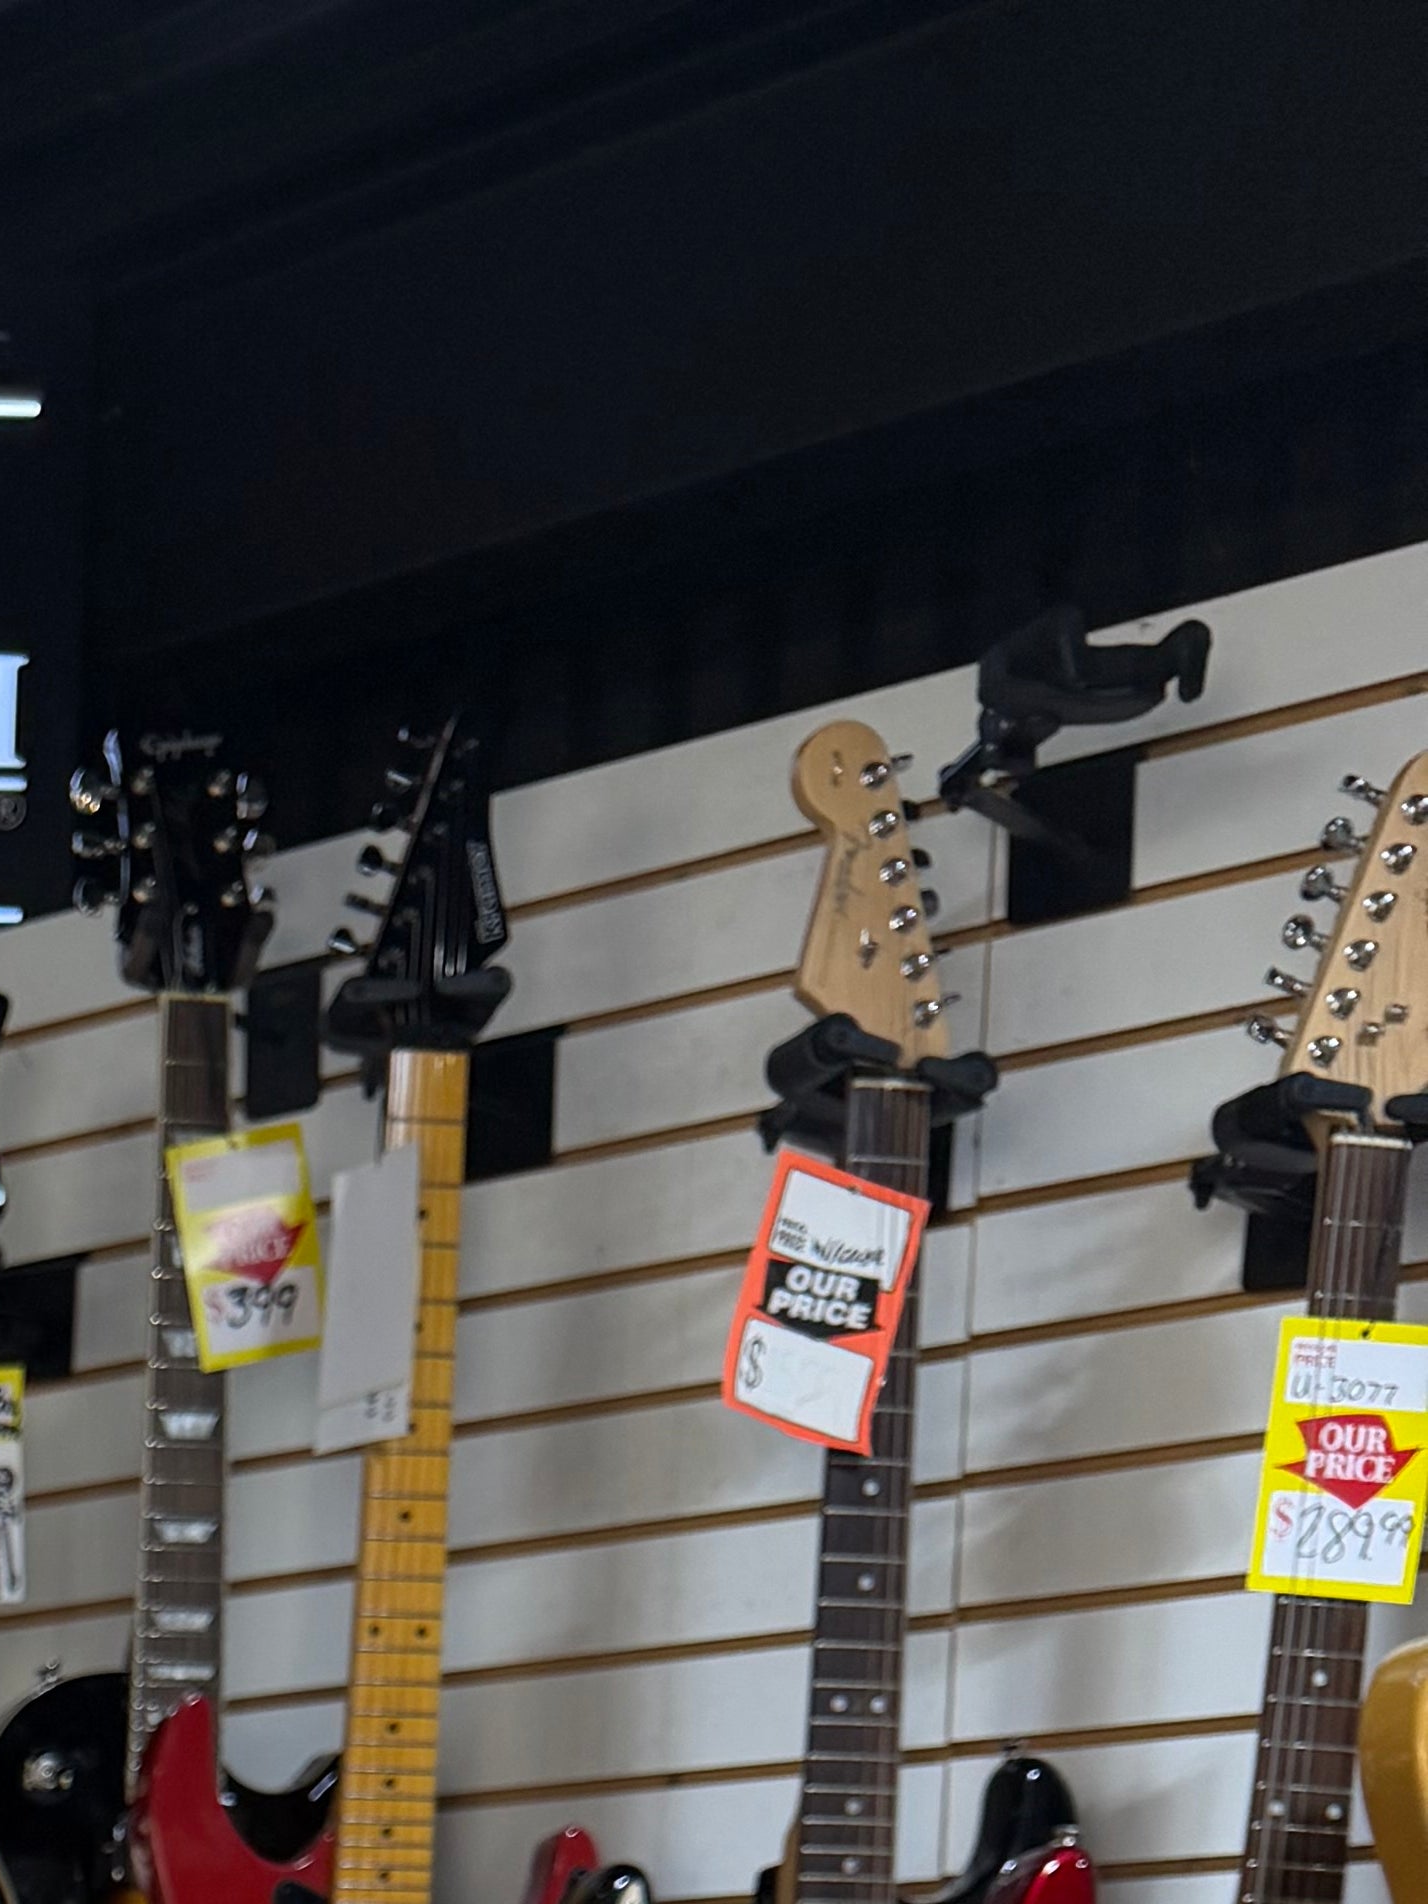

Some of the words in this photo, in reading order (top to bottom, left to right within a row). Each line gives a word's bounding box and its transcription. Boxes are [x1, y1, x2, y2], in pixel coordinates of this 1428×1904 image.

[785, 1264, 861, 1301] OUR
[766, 1287, 873, 1330] PRICE
[741, 1335, 766, 1390] $
[1317, 1421, 1388, 1454] OUR
[1303, 1451, 1396, 1484] PRICE
